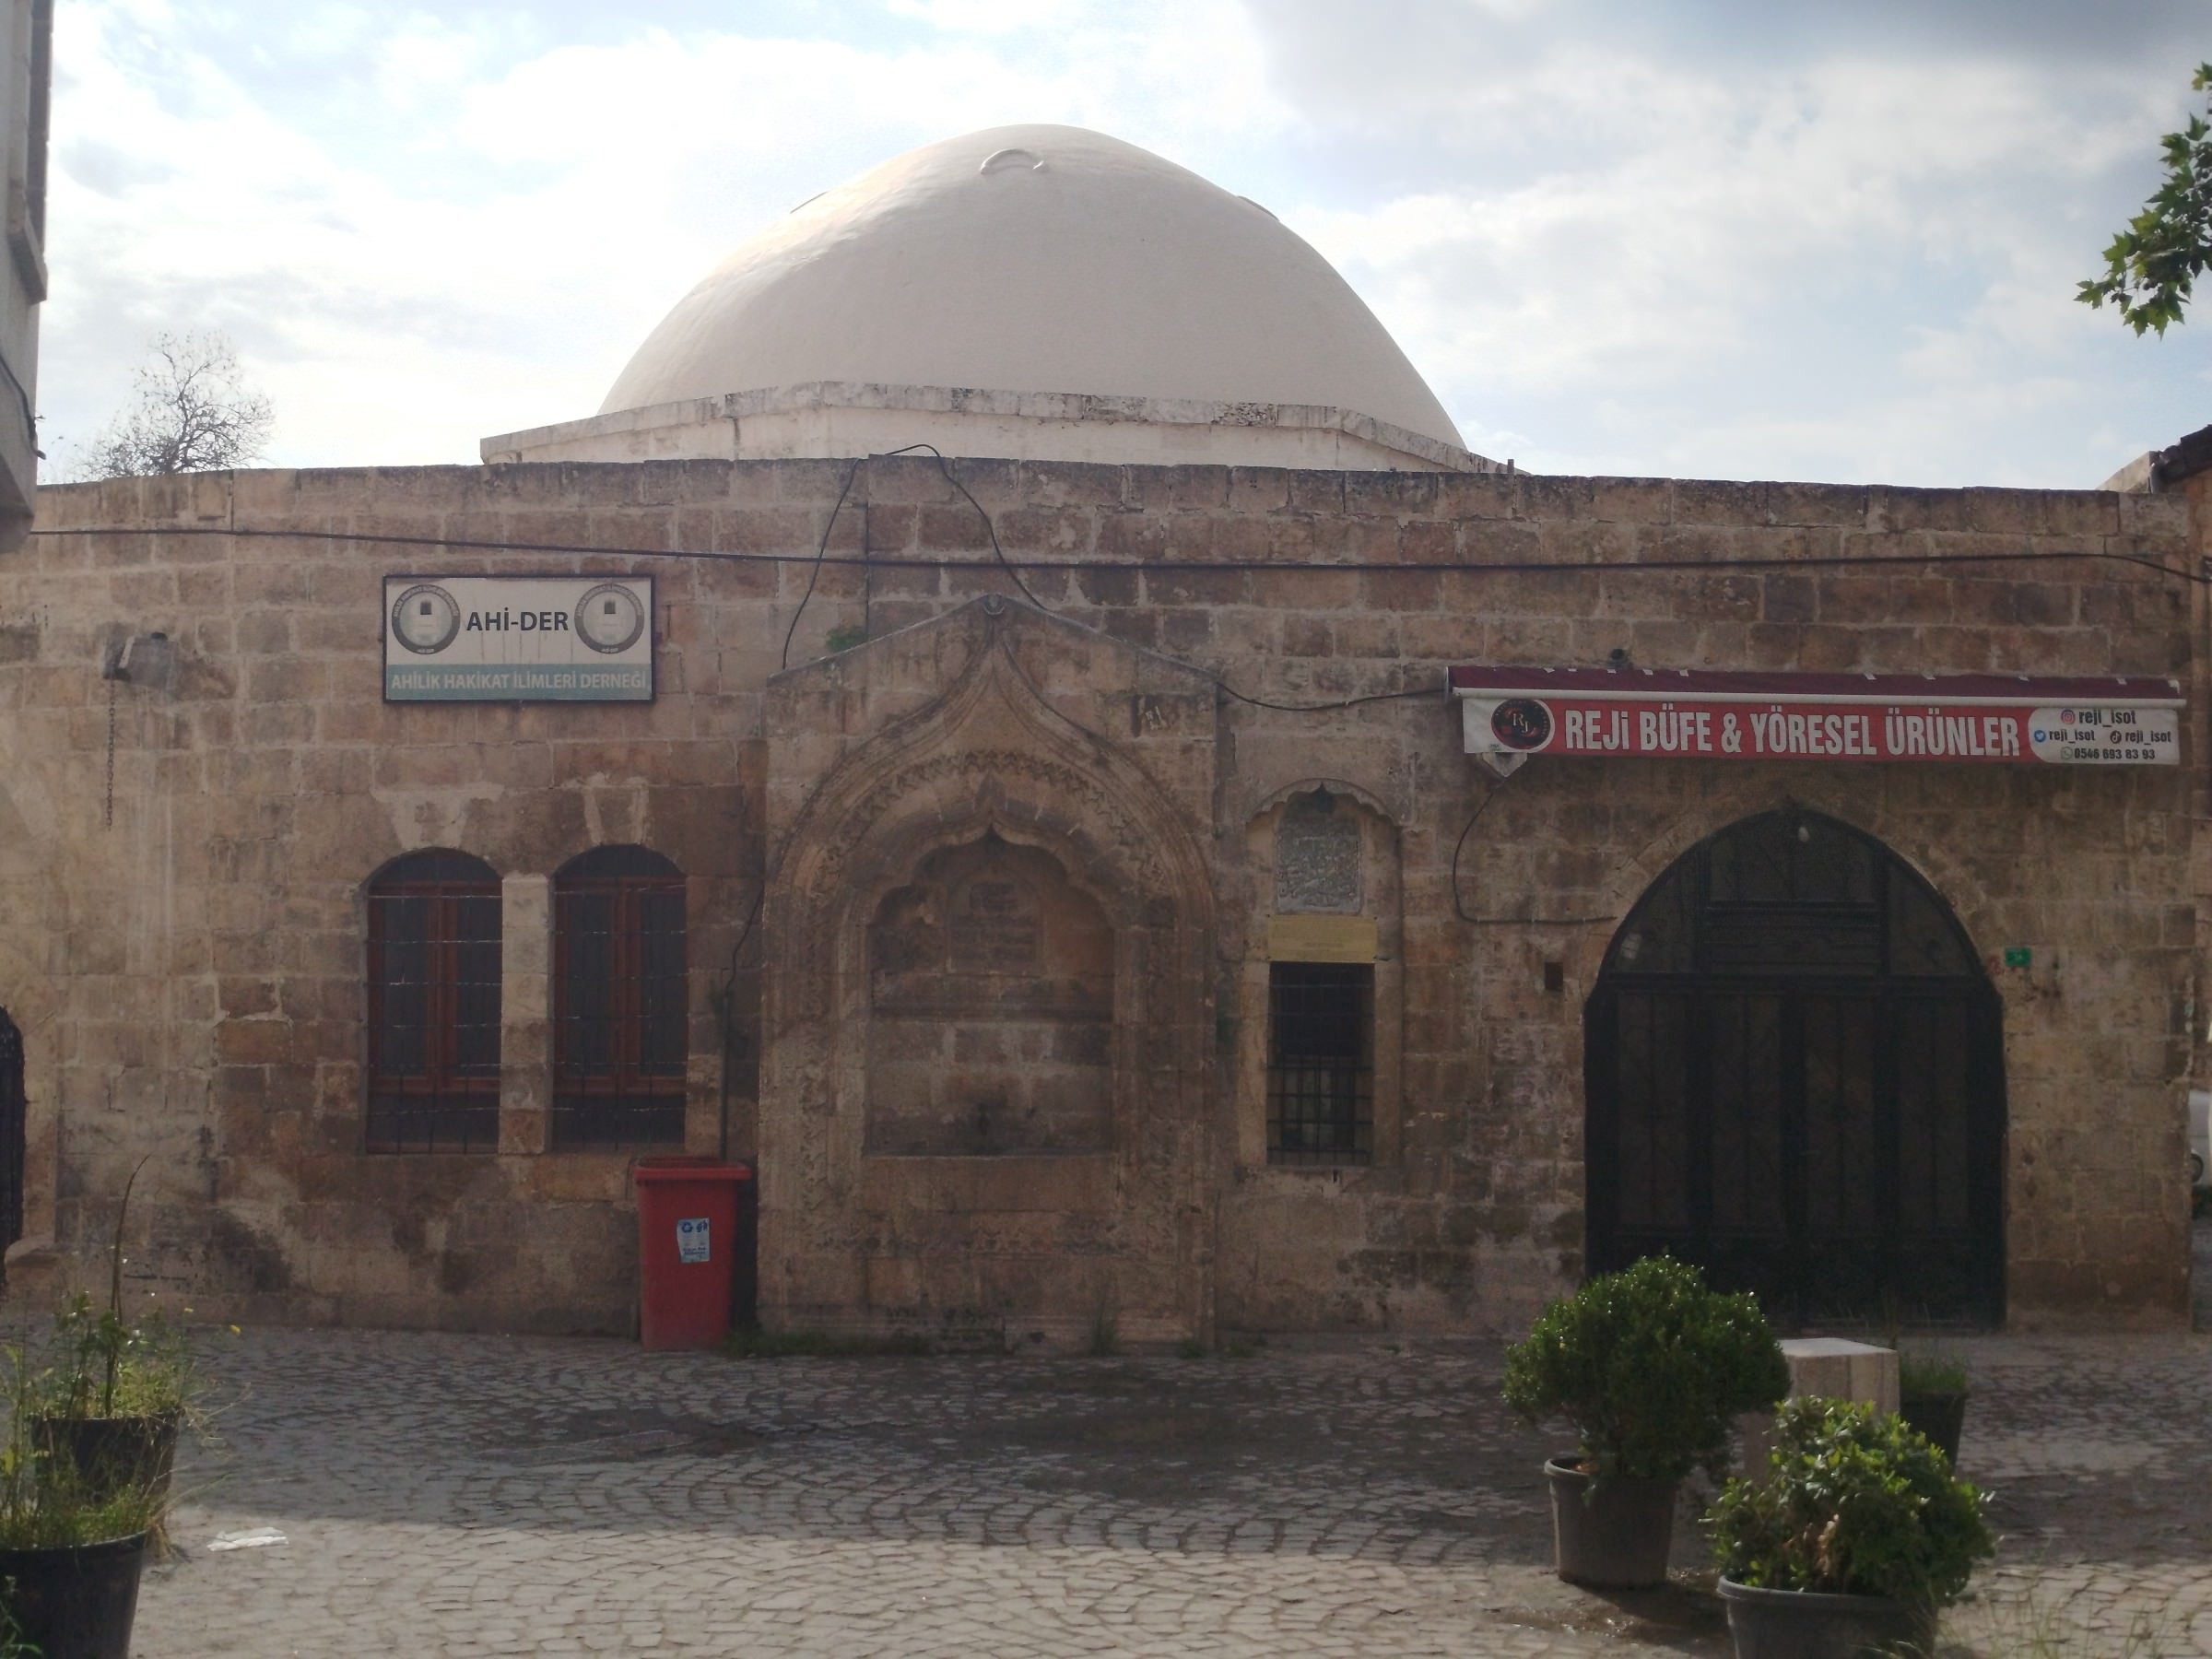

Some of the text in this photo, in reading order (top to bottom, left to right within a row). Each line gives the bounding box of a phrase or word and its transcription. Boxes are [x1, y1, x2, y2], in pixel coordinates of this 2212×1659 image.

[466, 607, 570, 631] AHİ-DER
[392, 671, 646, 690] AHİLİK HAKİKAT İLİMLERİ DERNEĞİ
[2078, 710, 2136, 728] reji_isot
[1640, 703, 1712, 752] BÜFE
[1722, 712, 1742, 753] &
[1750, 705, 1877, 756] YÖRESEL
[1885, 708, 2019, 757] ÜRÜNLER
[2142, 748, 2156, 759] 93
